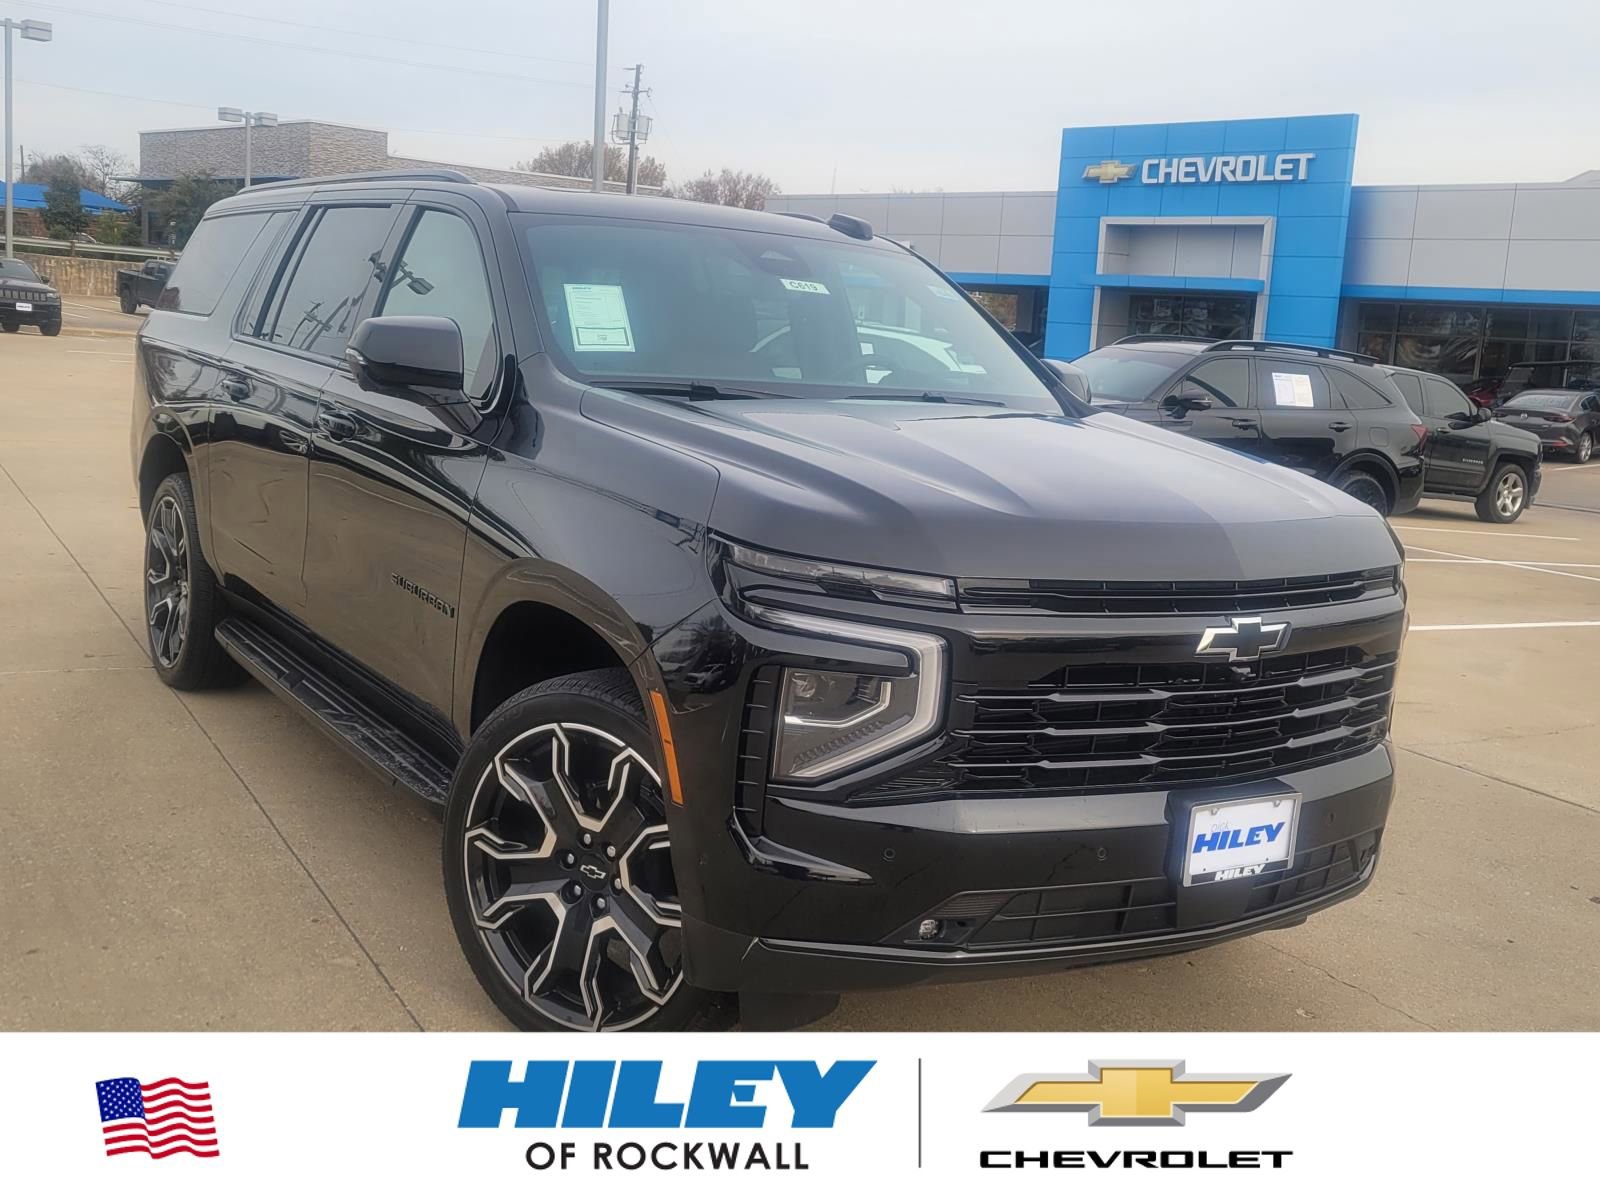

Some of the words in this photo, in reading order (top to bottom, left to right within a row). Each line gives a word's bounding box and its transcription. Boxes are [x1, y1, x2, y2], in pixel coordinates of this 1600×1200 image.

[1141, 153, 1316, 184] CHEVROLET
[391, 572, 456, 618] SUBURBAN
[1193, 822, 1284, 853] HILEY
[1215, 865, 1265, 881] HILEY
